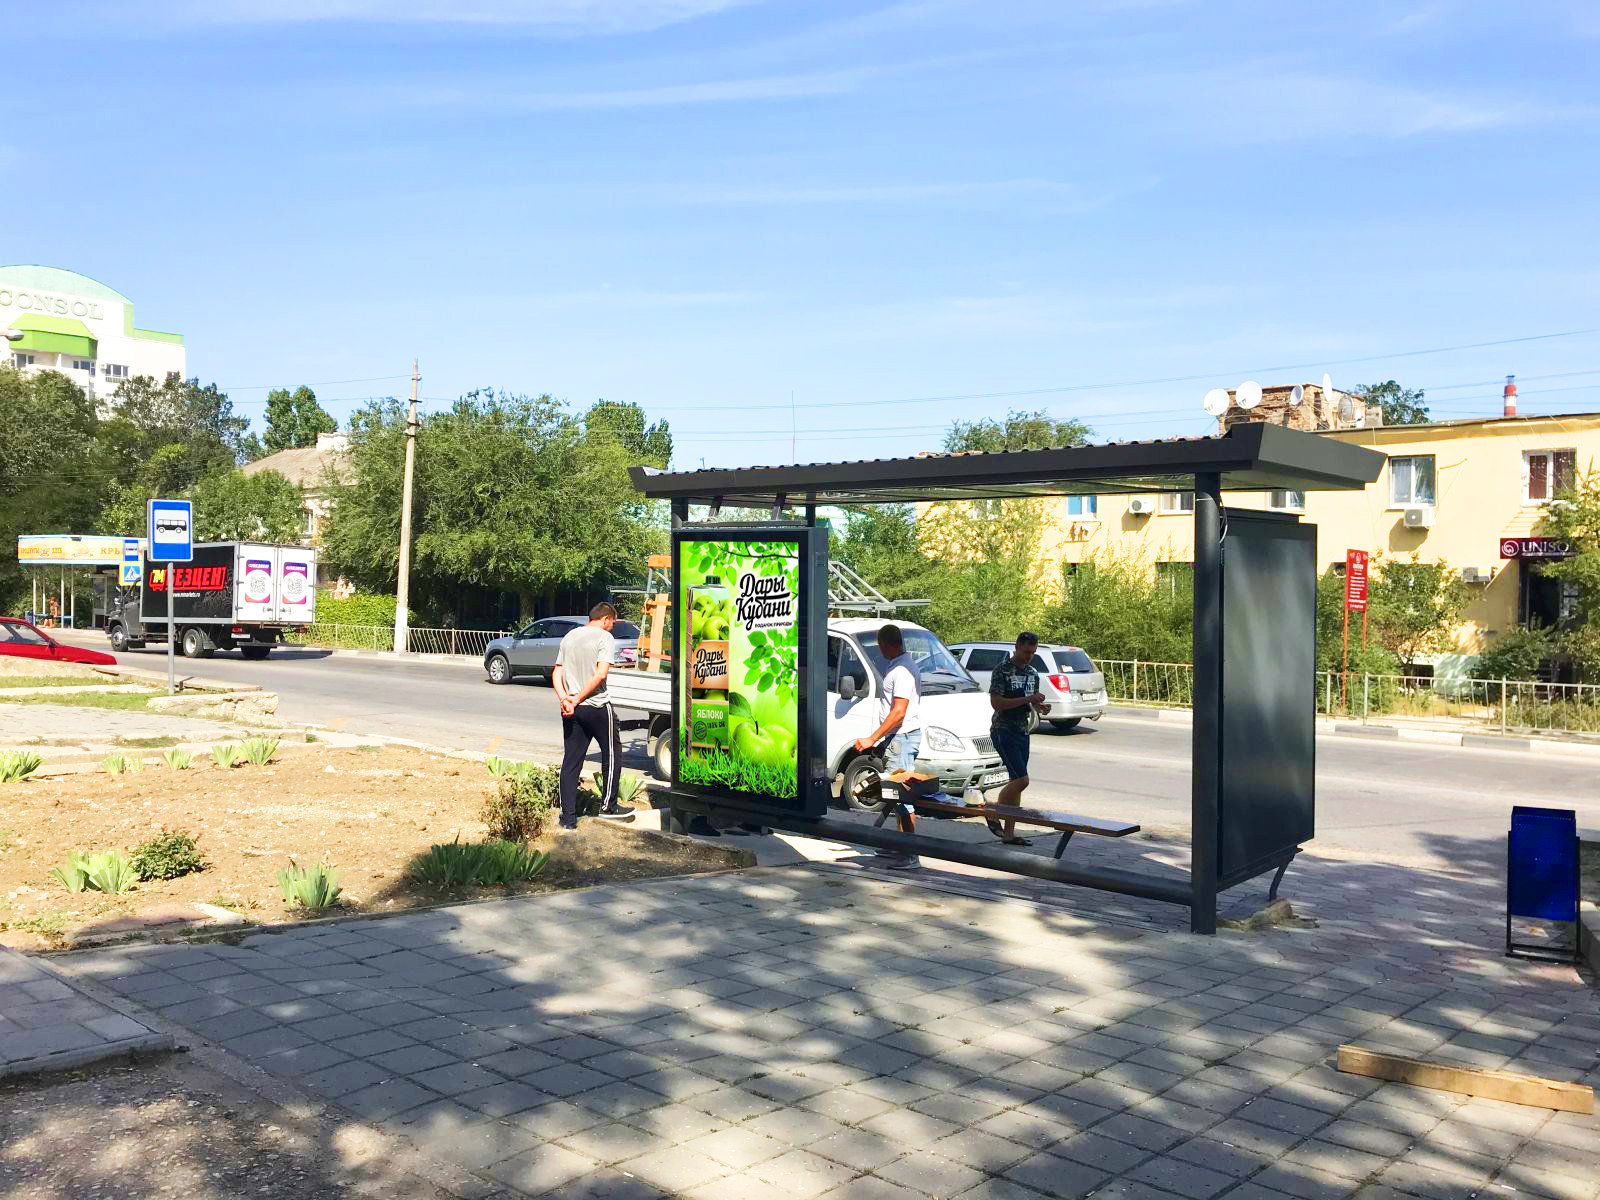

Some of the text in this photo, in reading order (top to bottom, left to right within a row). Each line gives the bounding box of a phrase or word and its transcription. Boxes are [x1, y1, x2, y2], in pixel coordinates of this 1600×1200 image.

[0, 289, 104, 321] CONSOL
[1522, 541, 1573, 553] UNISO
[739, 573, 787, 599] Дары
[736, 595, 792, 631] Кубани
[696, 648, 725, 666] Дары
[693, 661, 728, 684] Кубани
[697, 708, 724, 720] ЯБЛОКО
